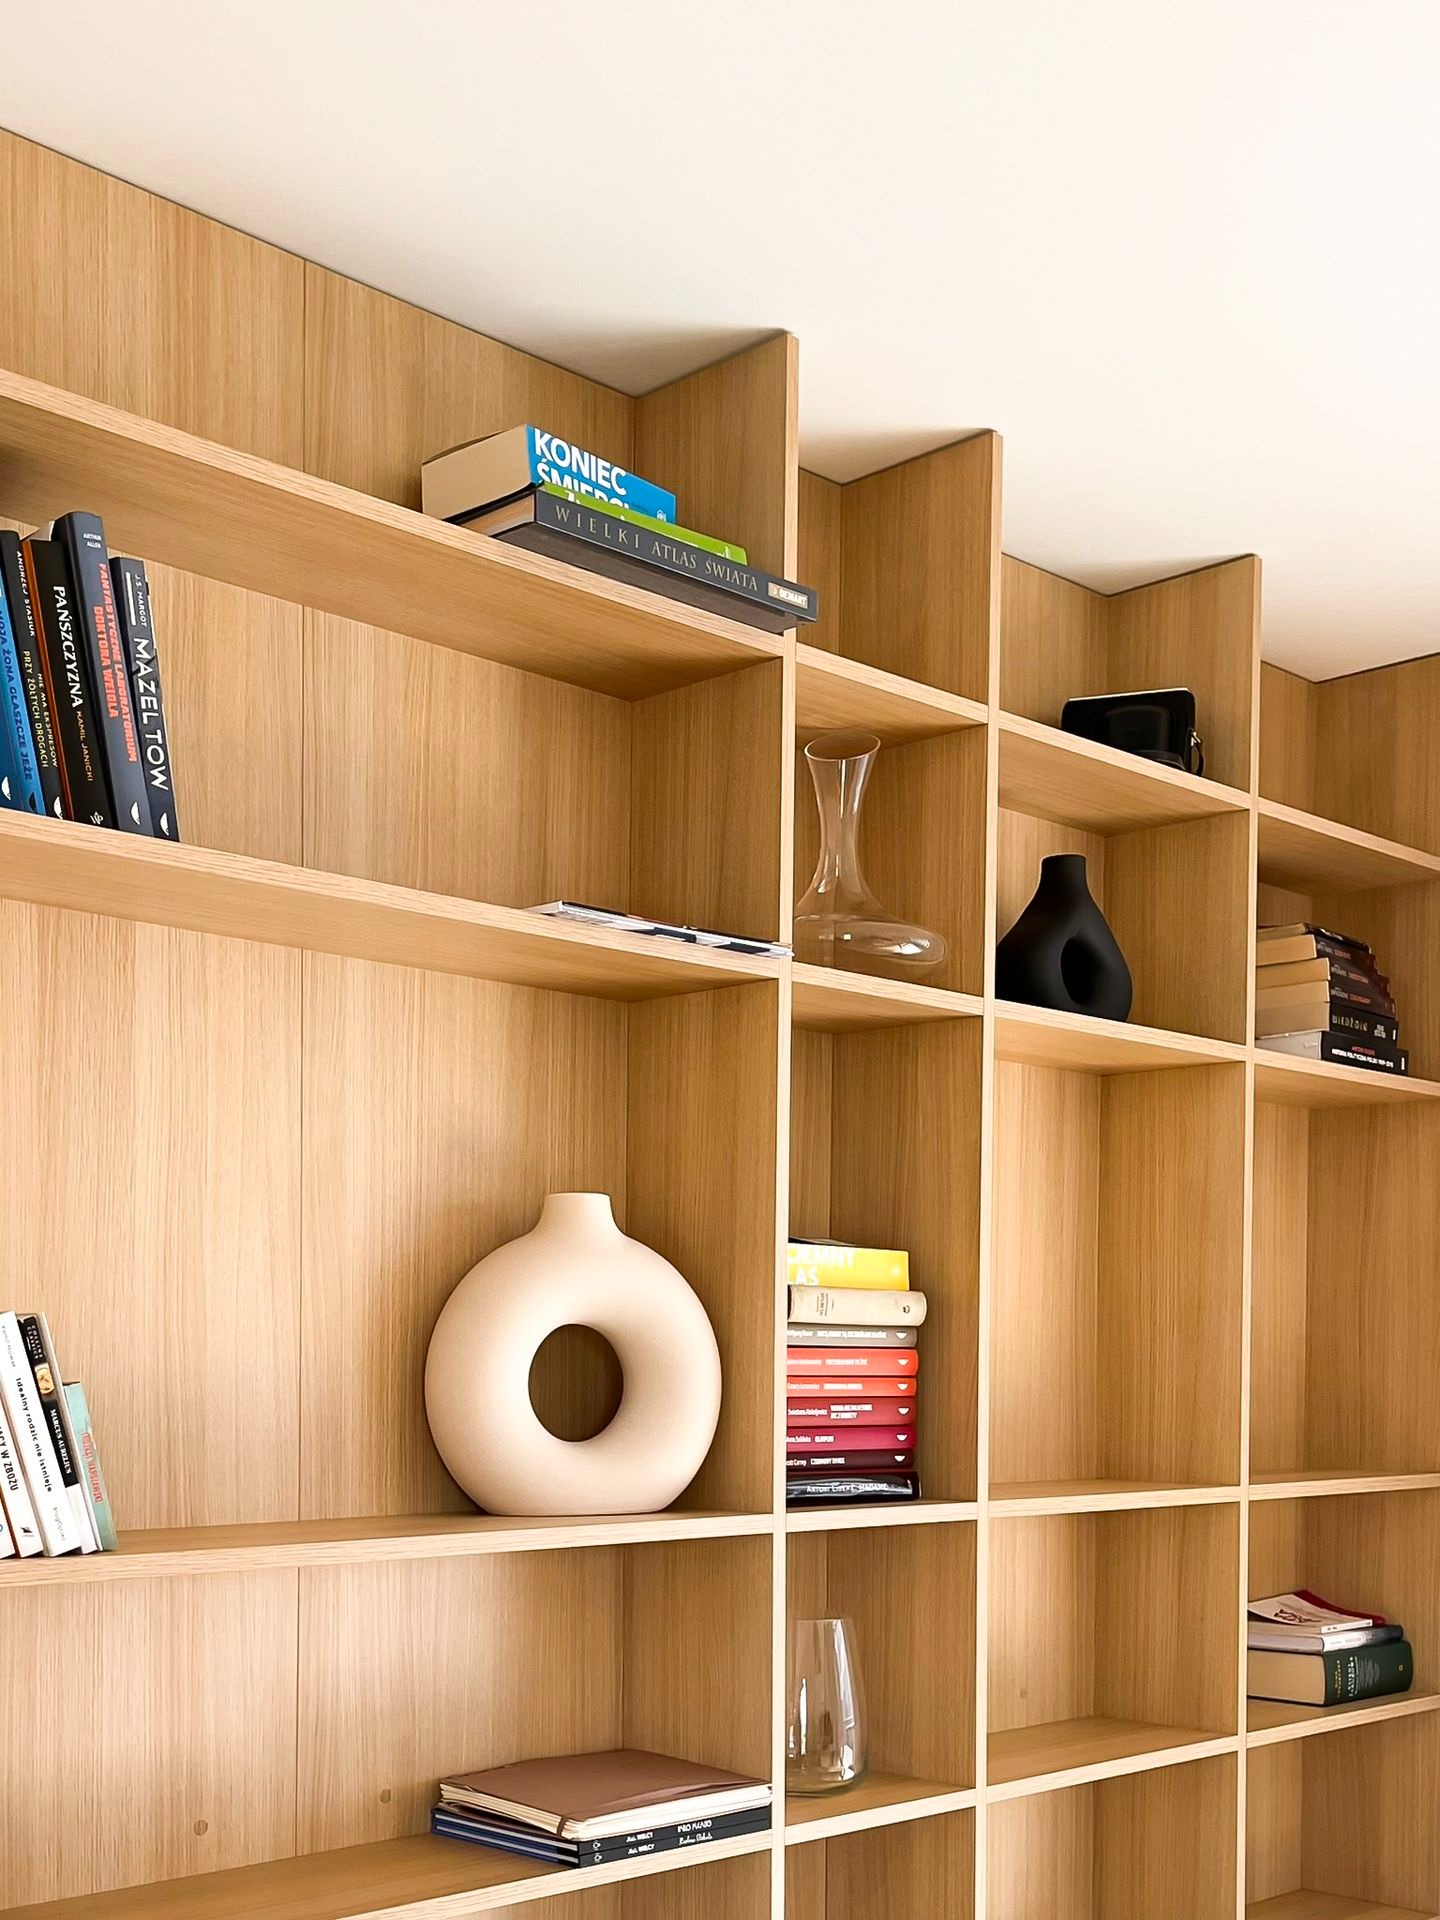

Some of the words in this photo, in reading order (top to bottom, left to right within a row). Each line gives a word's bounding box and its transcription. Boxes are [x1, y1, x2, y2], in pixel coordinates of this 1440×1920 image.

[534, 428, 627, 496] KONIEC
[555, 505, 642, 548] WIELKI
[651, 541, 697, 571] ATLAS
[705, 557, 758, 592] ŚWIATA
[24, 599, 35, 637] STASIUK
[94, 606, 111, 666] DOKTORA
[137, 591, 148, 628] MARGOT
[53, 586, 83, 708] PAŃSZCZYZNA
[133, 637, 159, 725] MAZEL
[3, 649, 15, 683] ŻONA
[10, 688, 27, 749] GŁASZCZE
[21, 752, 32, 781] JEŻE
[23, 650, 33, 674] PRZY
[35, 723, 48, 768] DROGACH
[76, 710, 86, 741] KAMIL
[81, 742, 93, 782] JANICKI
[145, 729, 170, 791] TOW
[26, 1413, 38, 1442] rodzic
[39, 1458, 52, 1493] istnieje
[49, 1408, 62, 1438] MARCUS
[3, 1461, 19, 1491] ZBOŻU
